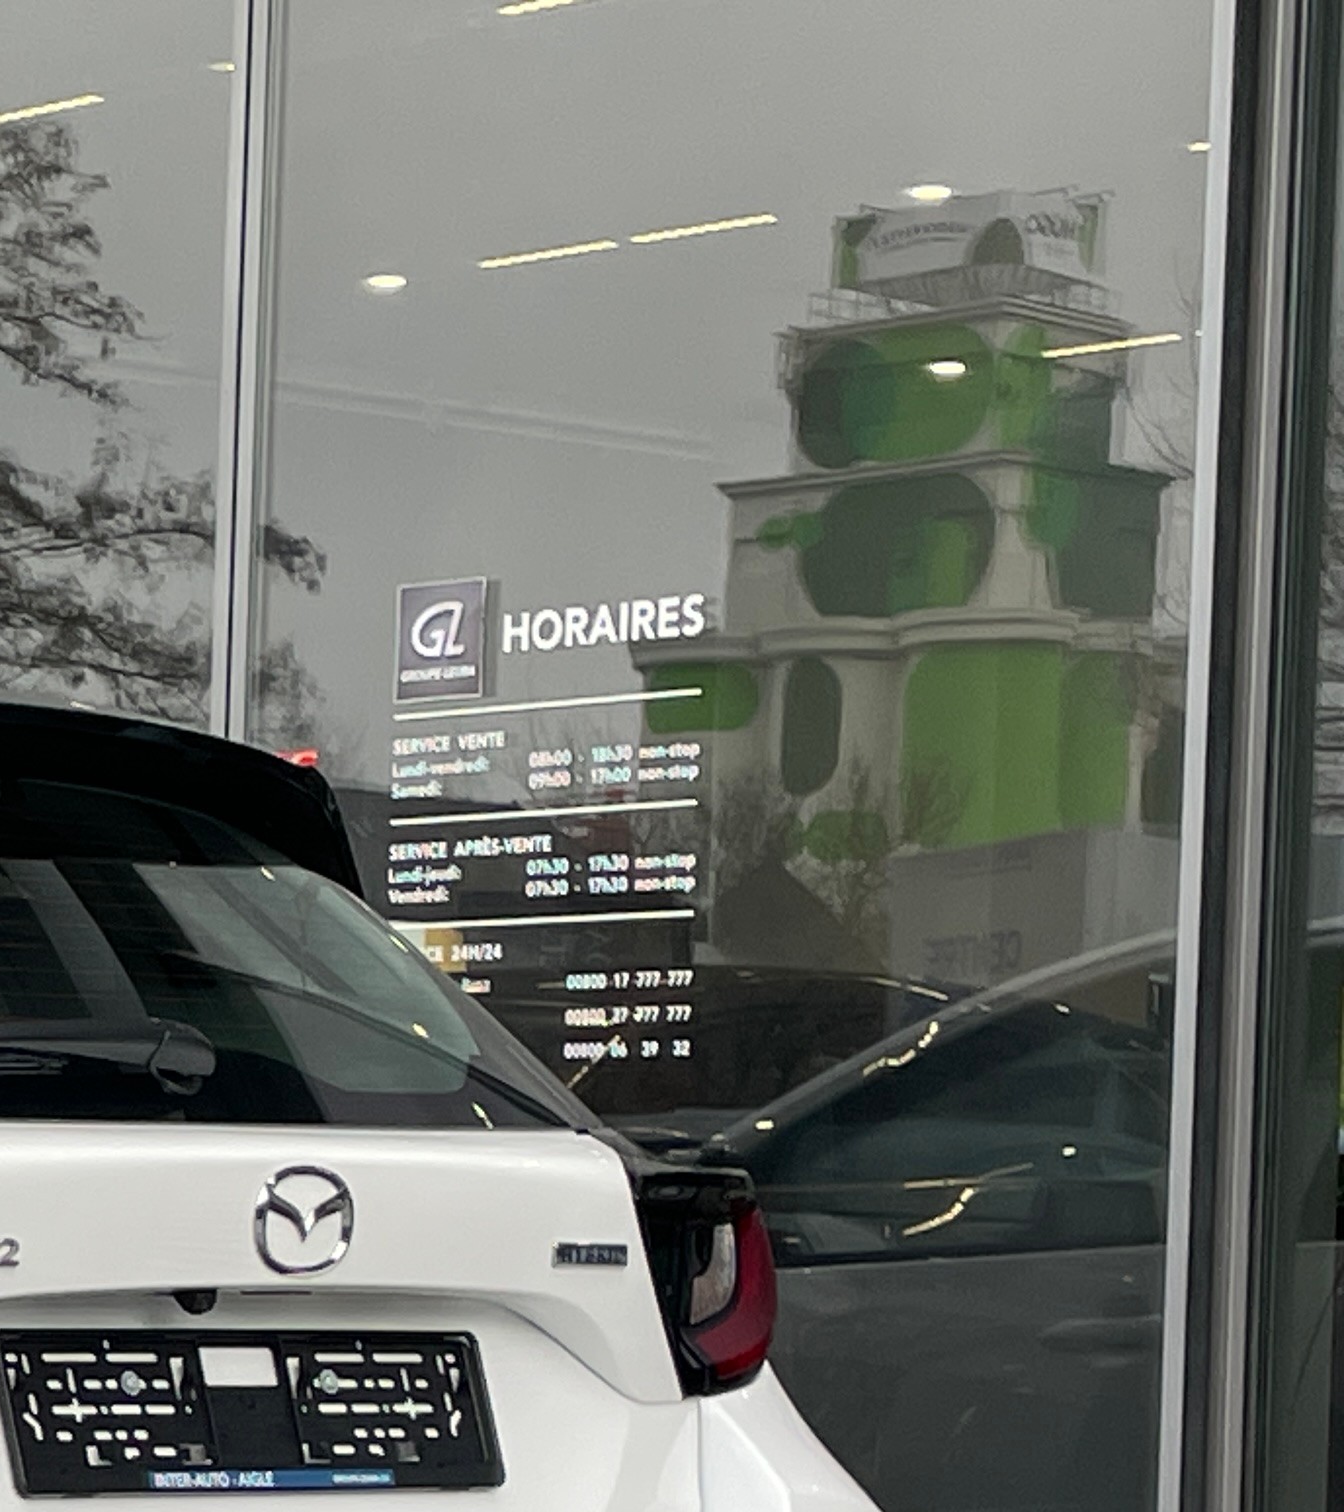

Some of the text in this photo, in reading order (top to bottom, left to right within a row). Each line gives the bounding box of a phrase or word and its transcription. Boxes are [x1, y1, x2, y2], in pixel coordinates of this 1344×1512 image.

[502, 593, 705, 653] HORAIRES
[391, 731, 505, 755] SERVICE VENTE
[388, 834, 553, 861] SERVICE APRÈS-VENTE
[451, 943, 503, 961] 24H/24
[613, 972, 630, 988] 17
[636, 971, 661, 987] 777
[667, 970, 694, 987] 777
[665, 1005, 692, 1022] 777
[153, 1471, 229, 1488] INTER-AUTO
[238, 1471, 276, 1488] AIGLE
